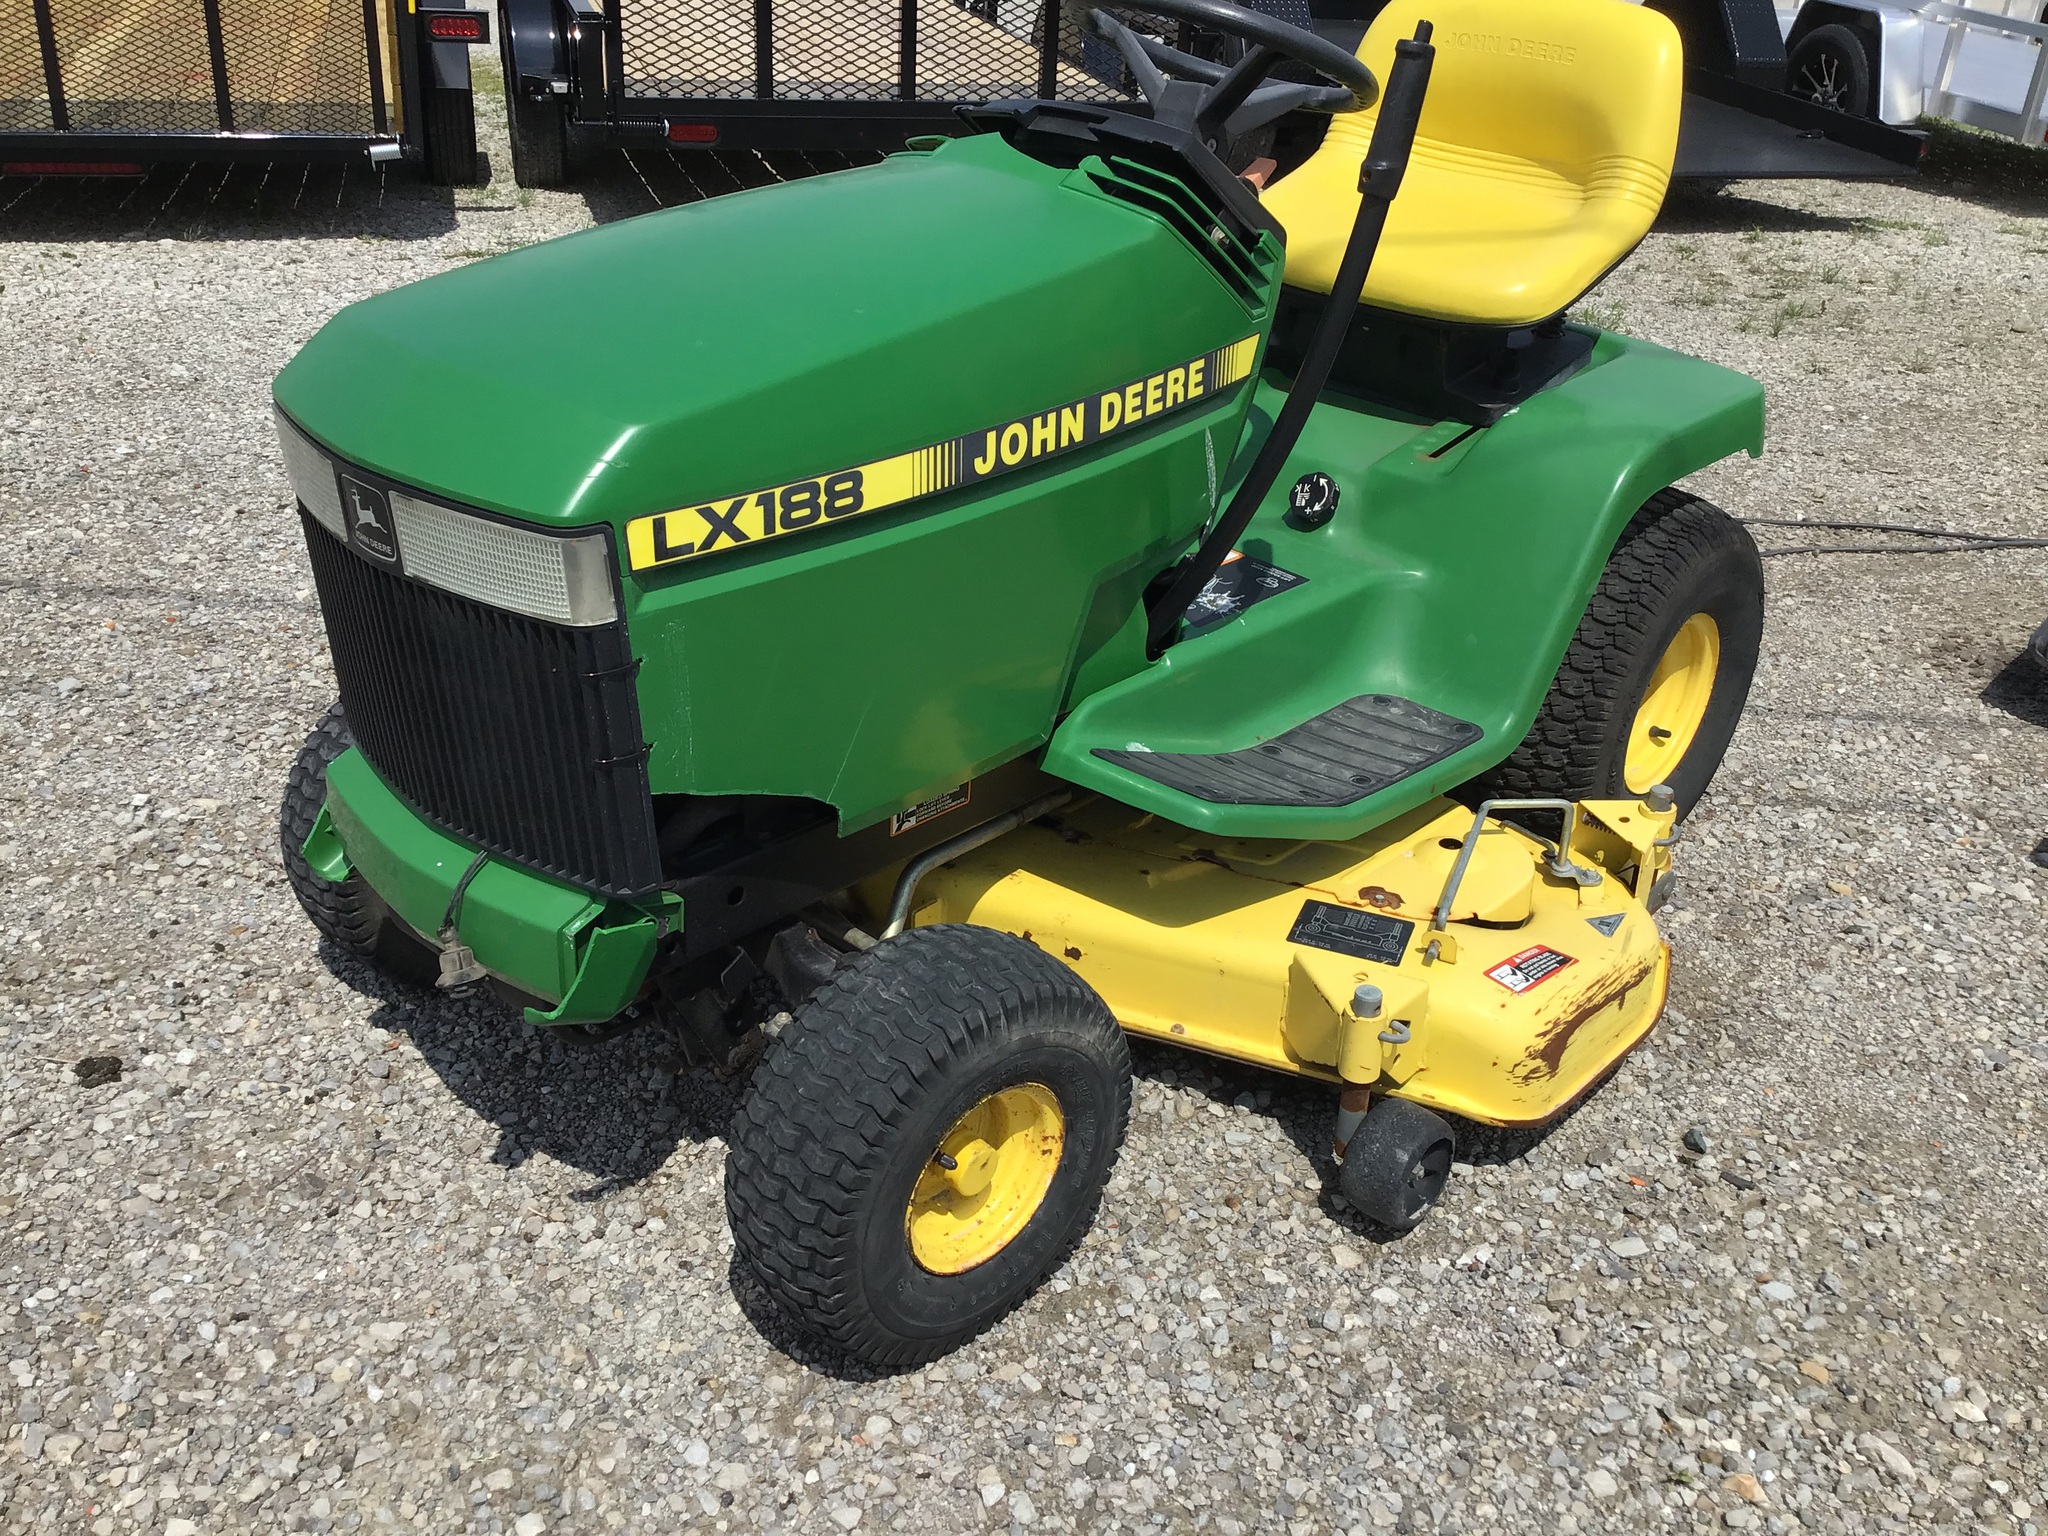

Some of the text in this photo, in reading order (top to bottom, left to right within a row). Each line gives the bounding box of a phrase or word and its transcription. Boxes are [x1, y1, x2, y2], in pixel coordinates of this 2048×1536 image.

[1443, 32, 1577, 66] JOHN DEERE
[972, 357, 1206, 477] JOHN DEERE
[369, 538, 393, 555] DEERE
[652, 468, 865, 564] LX188
